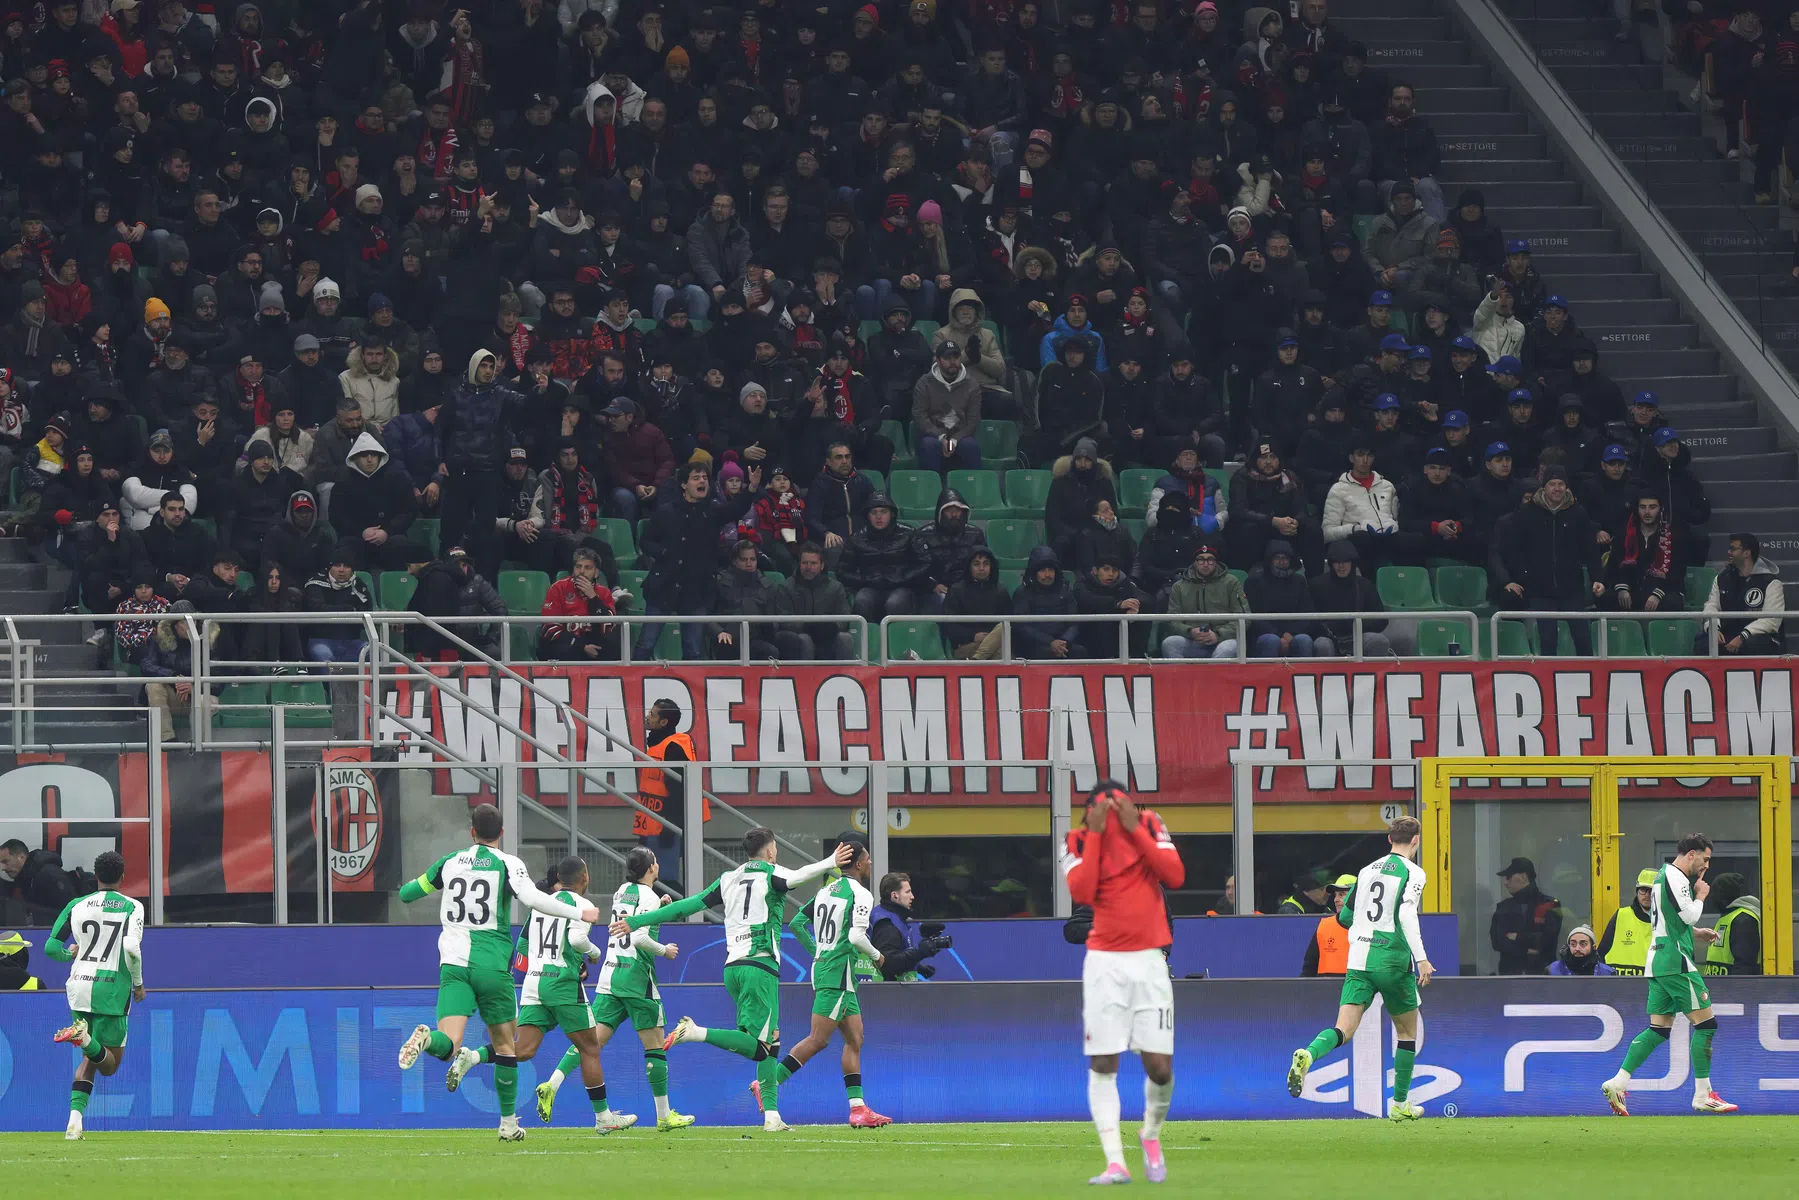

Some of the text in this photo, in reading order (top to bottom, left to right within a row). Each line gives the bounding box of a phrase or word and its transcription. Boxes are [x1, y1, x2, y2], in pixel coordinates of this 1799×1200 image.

[1382, 49, 1424, 57] SETTORE
[1456, 142, 1498, 151] SETTORE
[1527, 237, 1569, 247] SETTORE
[1608, 334, 1651, 343] SETTORE
[1686, 437, 1729, 446] SETTORE
[35, 654, 48, 667] 147
[1385, 805, 1396, 819] 21
[331, 854, 366, 870] 1967
[458, 856, 492, 868] HANCKO
[87, 900, 125, 909] MILAMBO
[446, 877, 490, 926] 33
[739, 879, 755, 920] 7
[1367, 881, 1385, 922] 3
[817, 903, 837, 944] 26
[80, 919, 123, 963] 27
[536, 917, 559, 960] 14
[1158, 1008, 1172, 1030] 10
